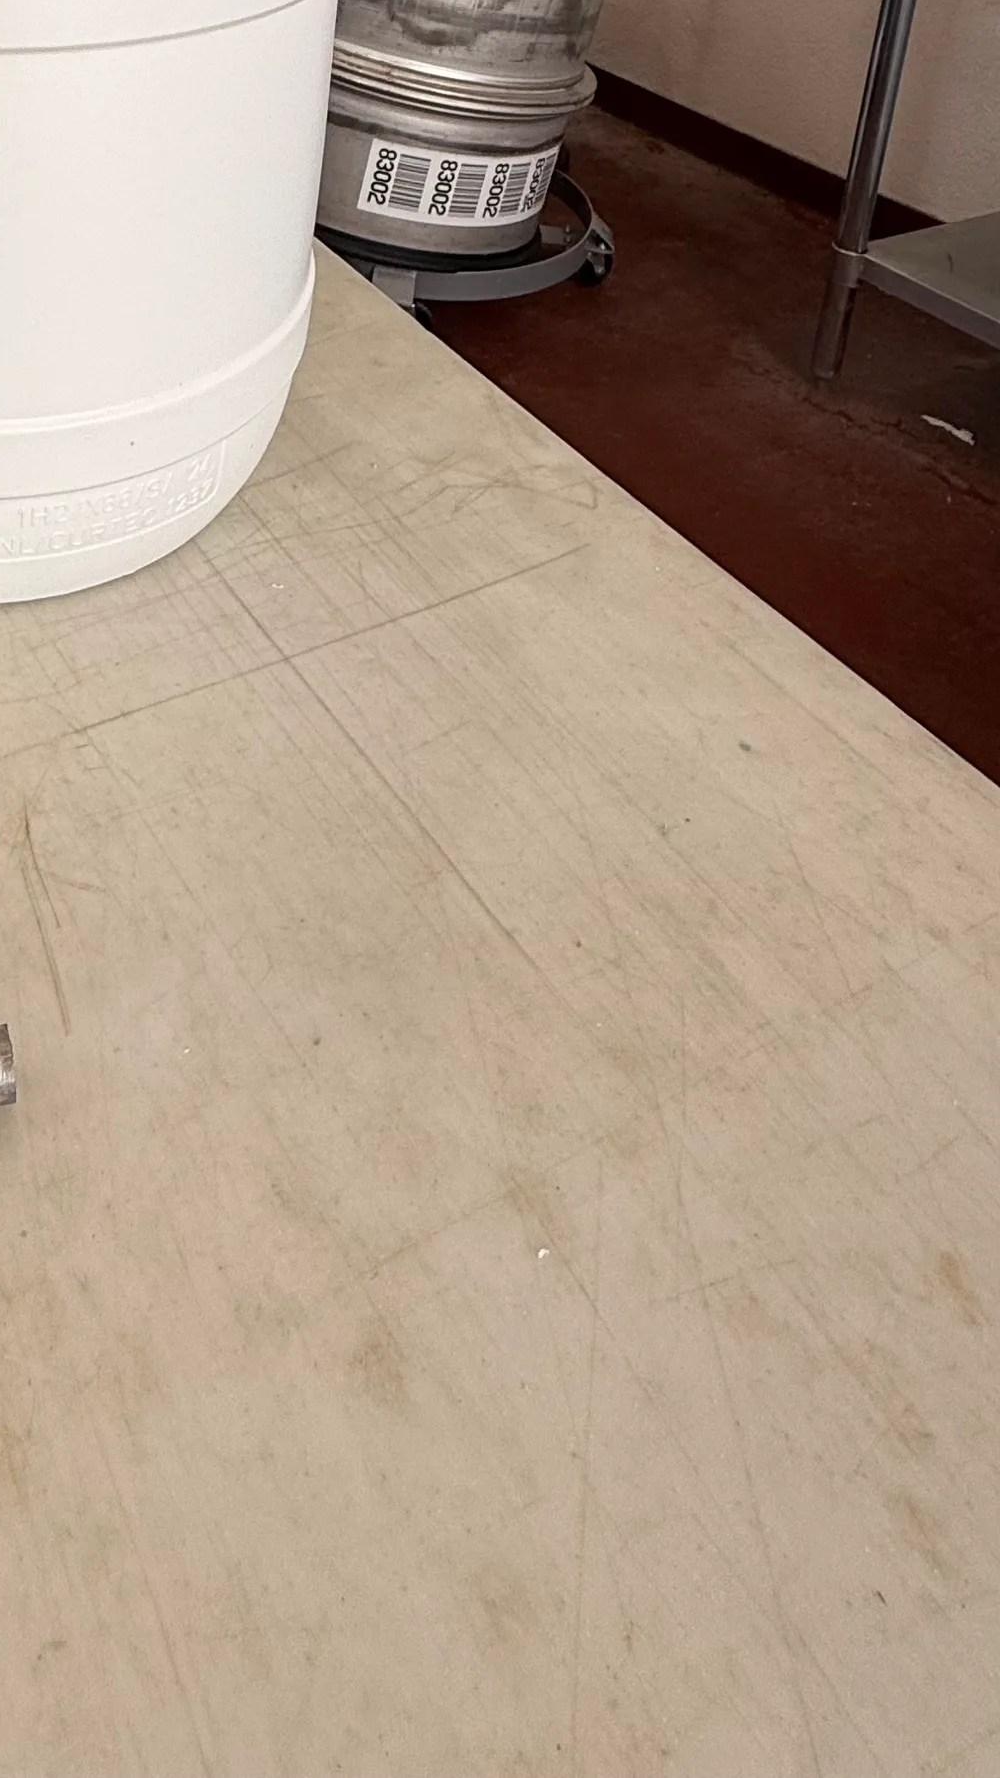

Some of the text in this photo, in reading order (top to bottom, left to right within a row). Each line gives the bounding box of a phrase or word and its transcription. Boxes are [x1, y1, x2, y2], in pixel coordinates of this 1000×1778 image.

[367, 148, 397, 206] 83002
[428, 160, 458, 216] 83002
[482, 163, 510, 218] 83002
[520, 157, 546, 213] 83002
